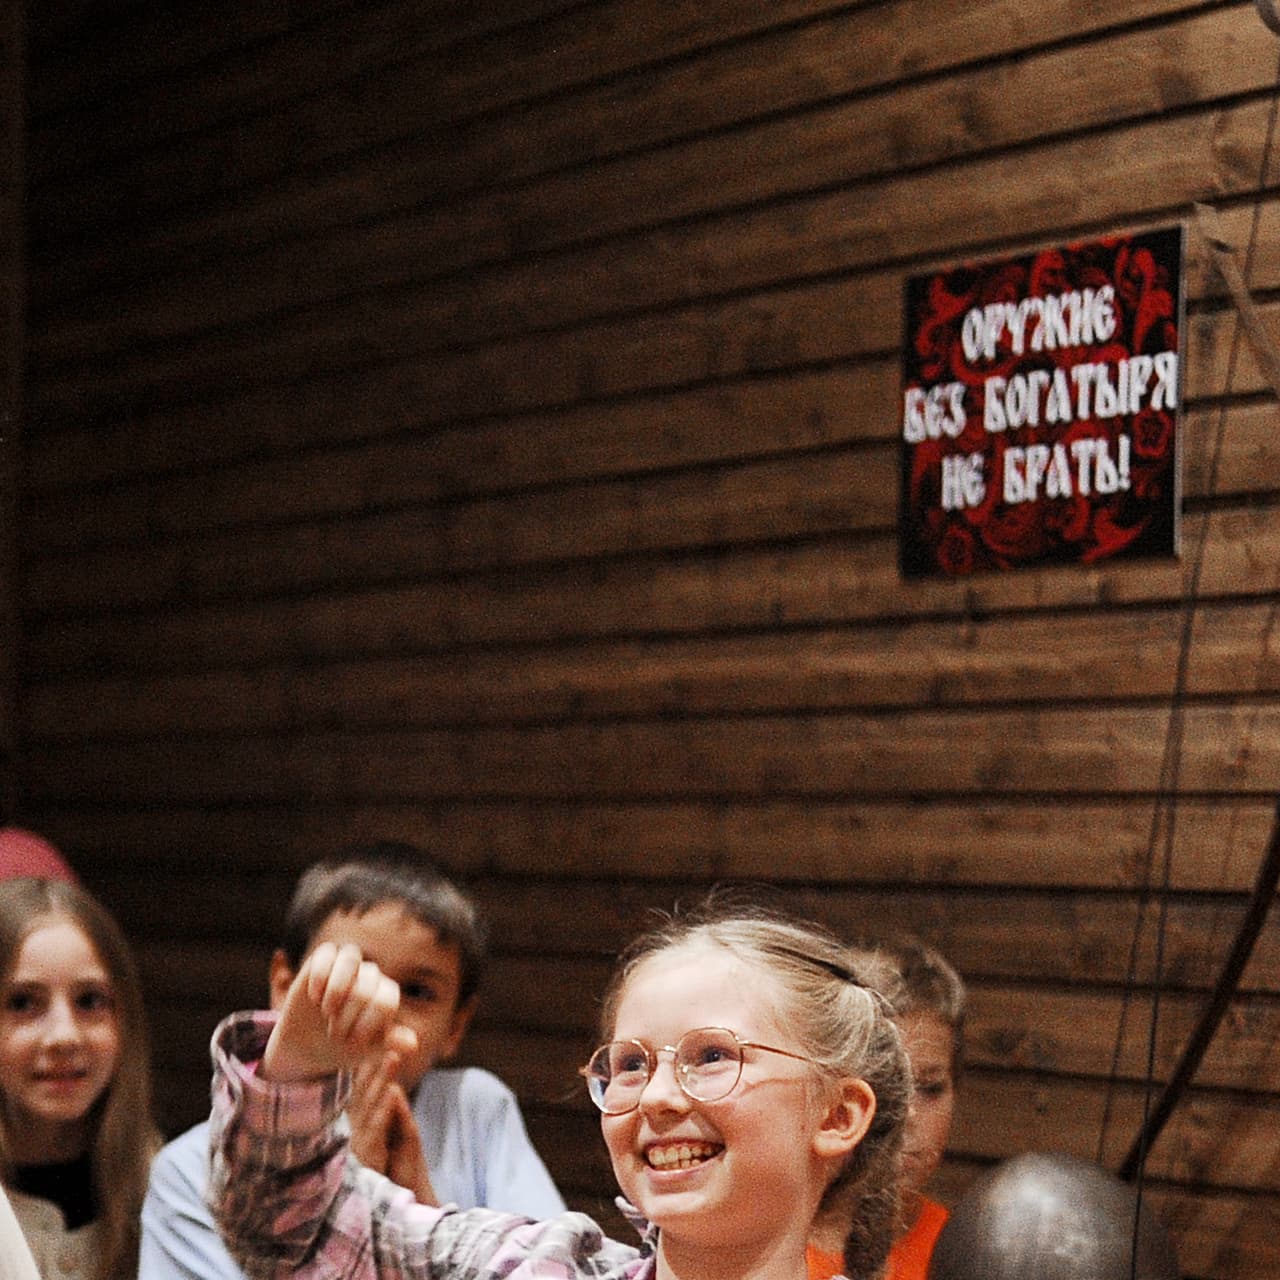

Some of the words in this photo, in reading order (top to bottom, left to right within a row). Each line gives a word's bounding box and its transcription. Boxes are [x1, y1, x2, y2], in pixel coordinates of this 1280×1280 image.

[961, 284, 1117, 363] ОРУЖИЕ
[903, 382, 967, 444] БЕЗ
[983, 350, 1179, 433] БОГАТЫРЯ
[941, 452, 986, 510] НЕ
[1003, 434, 1131, 504] БРАТЬ!
